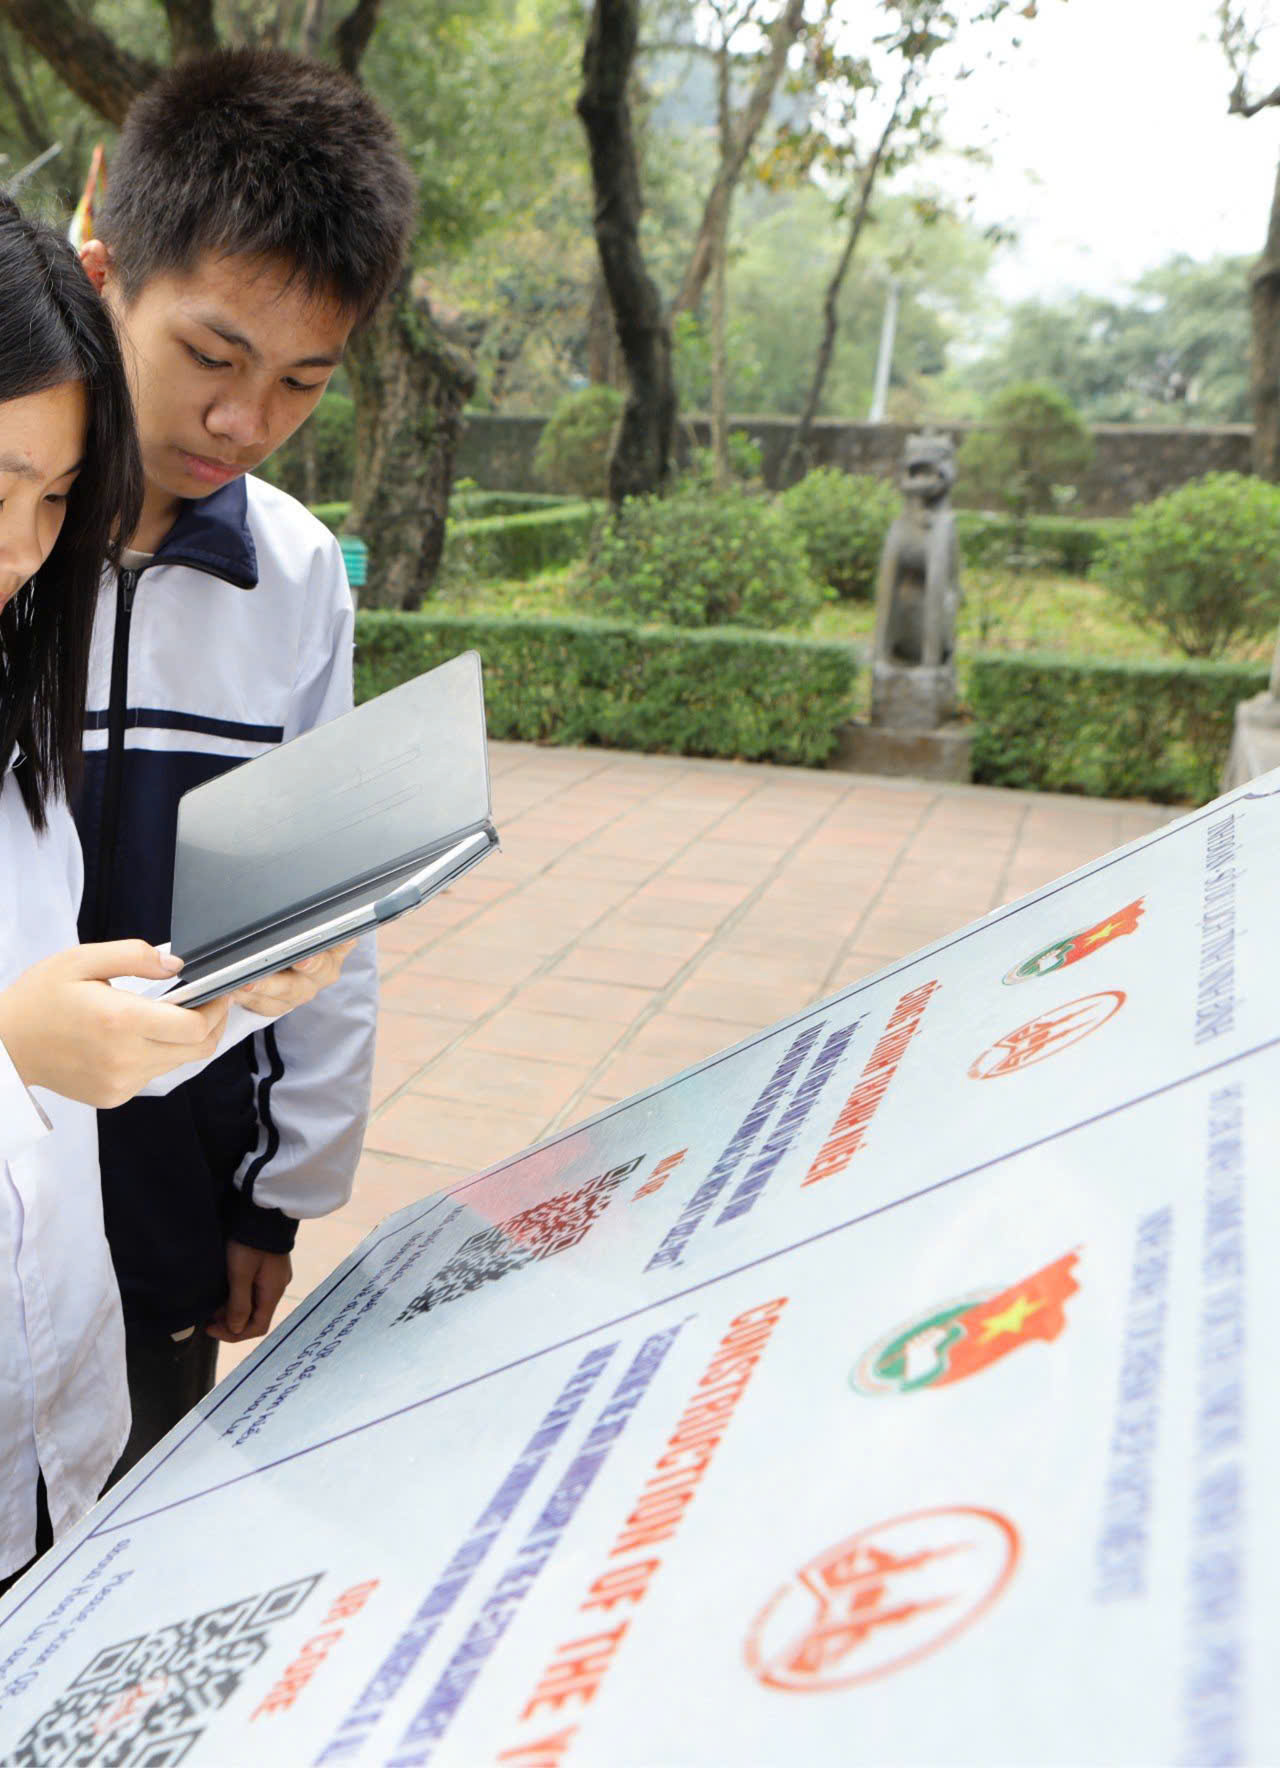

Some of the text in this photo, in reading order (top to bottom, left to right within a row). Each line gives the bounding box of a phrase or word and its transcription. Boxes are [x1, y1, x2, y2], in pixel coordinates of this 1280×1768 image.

[800, 980, 941, 1188] CÔNG TRÌNH THANH NIÊN
[608, 1296, 789, 1559] CONSTRUCTION
[70, 1569, 135, 1625] Please
[319, 1577, 380, 1627] QR
[580, 1558, 662, 1612] OF
[521, 1620, 631, 1720] THE
